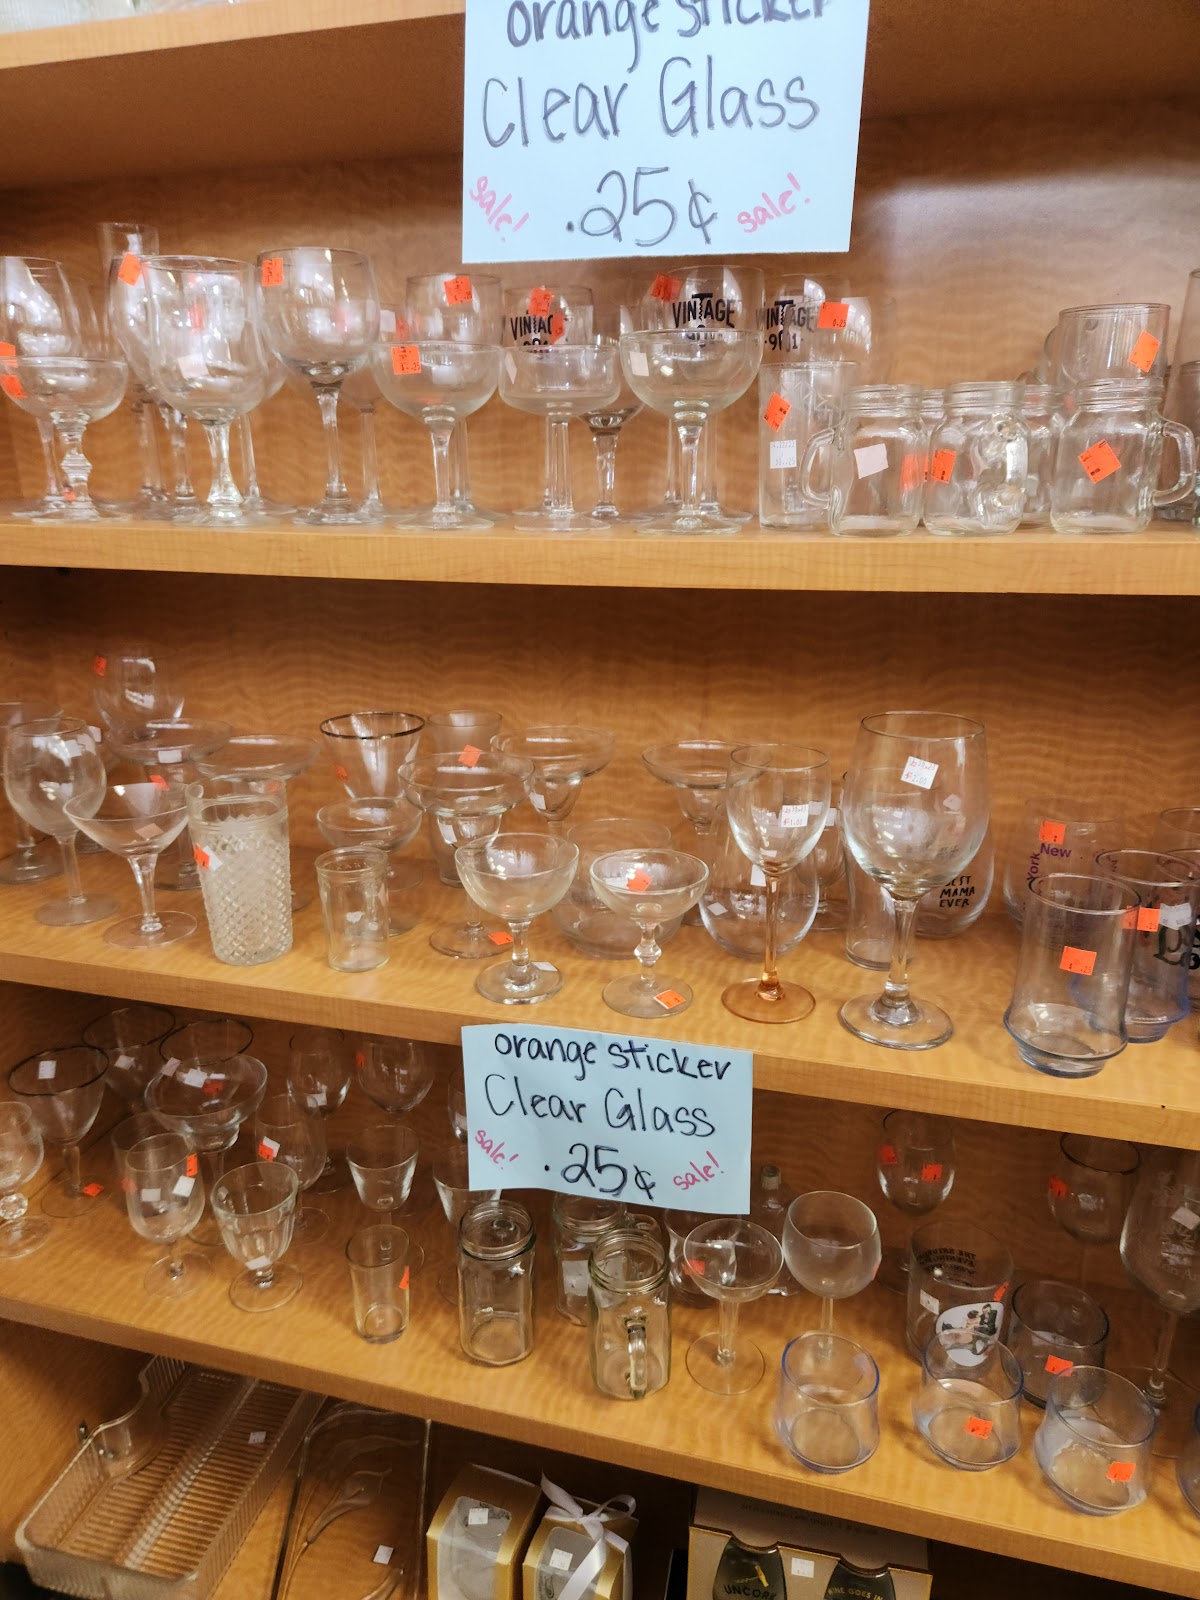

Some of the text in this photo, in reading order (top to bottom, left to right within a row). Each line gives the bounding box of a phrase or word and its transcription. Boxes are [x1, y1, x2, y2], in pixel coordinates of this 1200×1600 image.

[507, 0, 660, 73] orange
[482, 54, 821, 148] Clear Glass
[469, 176, 530, 243] sale!
[737, 172, 812, 234] sale!
[672, 293, 735, 328] VINTAGE
[1027, 852, 1041, 881] York
[1040, 843, 1072, 858] New
[940, 886, 975, 899] MAMA
[945, 875, 971, 887] EST
[940, 898, 970, 908] EVER
[494, 1033, 731, 1081] orange sticker
[484, 1074, 715, 1138] Clear Glass
[474, 1129, 519, 1170] sale!
[672, 1151, 725, 1190] sale!
